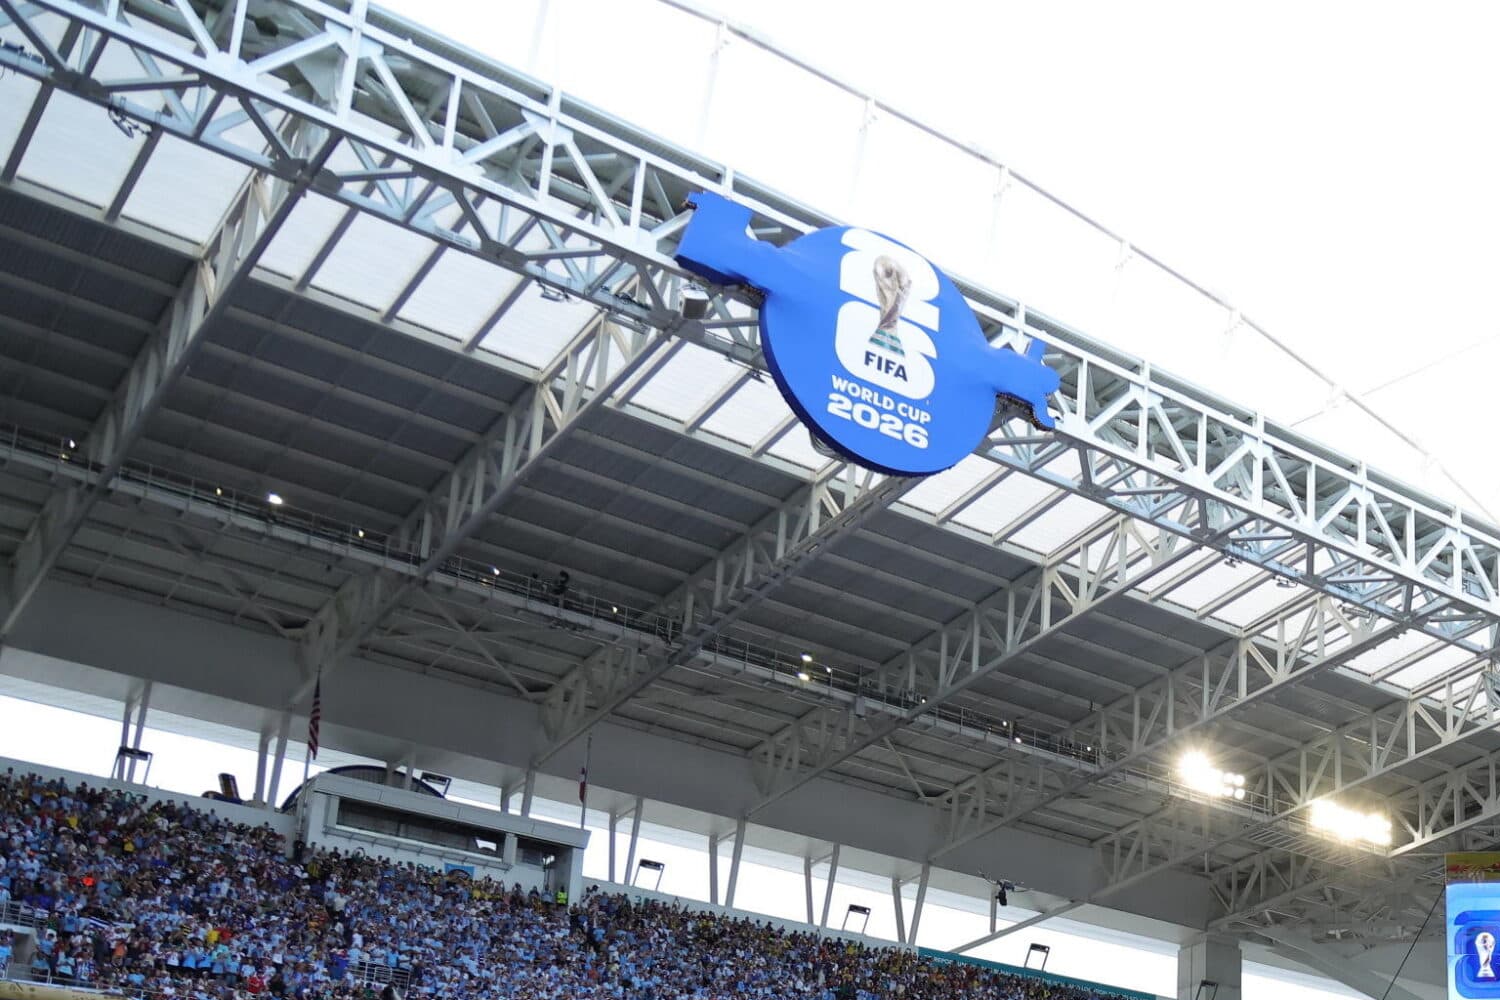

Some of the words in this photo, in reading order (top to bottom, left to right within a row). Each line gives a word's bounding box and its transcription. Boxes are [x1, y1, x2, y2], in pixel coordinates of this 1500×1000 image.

[864, 350, 908, 382] FIFA
[827, 392, 929, 449] 2026
[831, 374, 895, 411] WORLD
[897, 402, 931, 424] CUP
